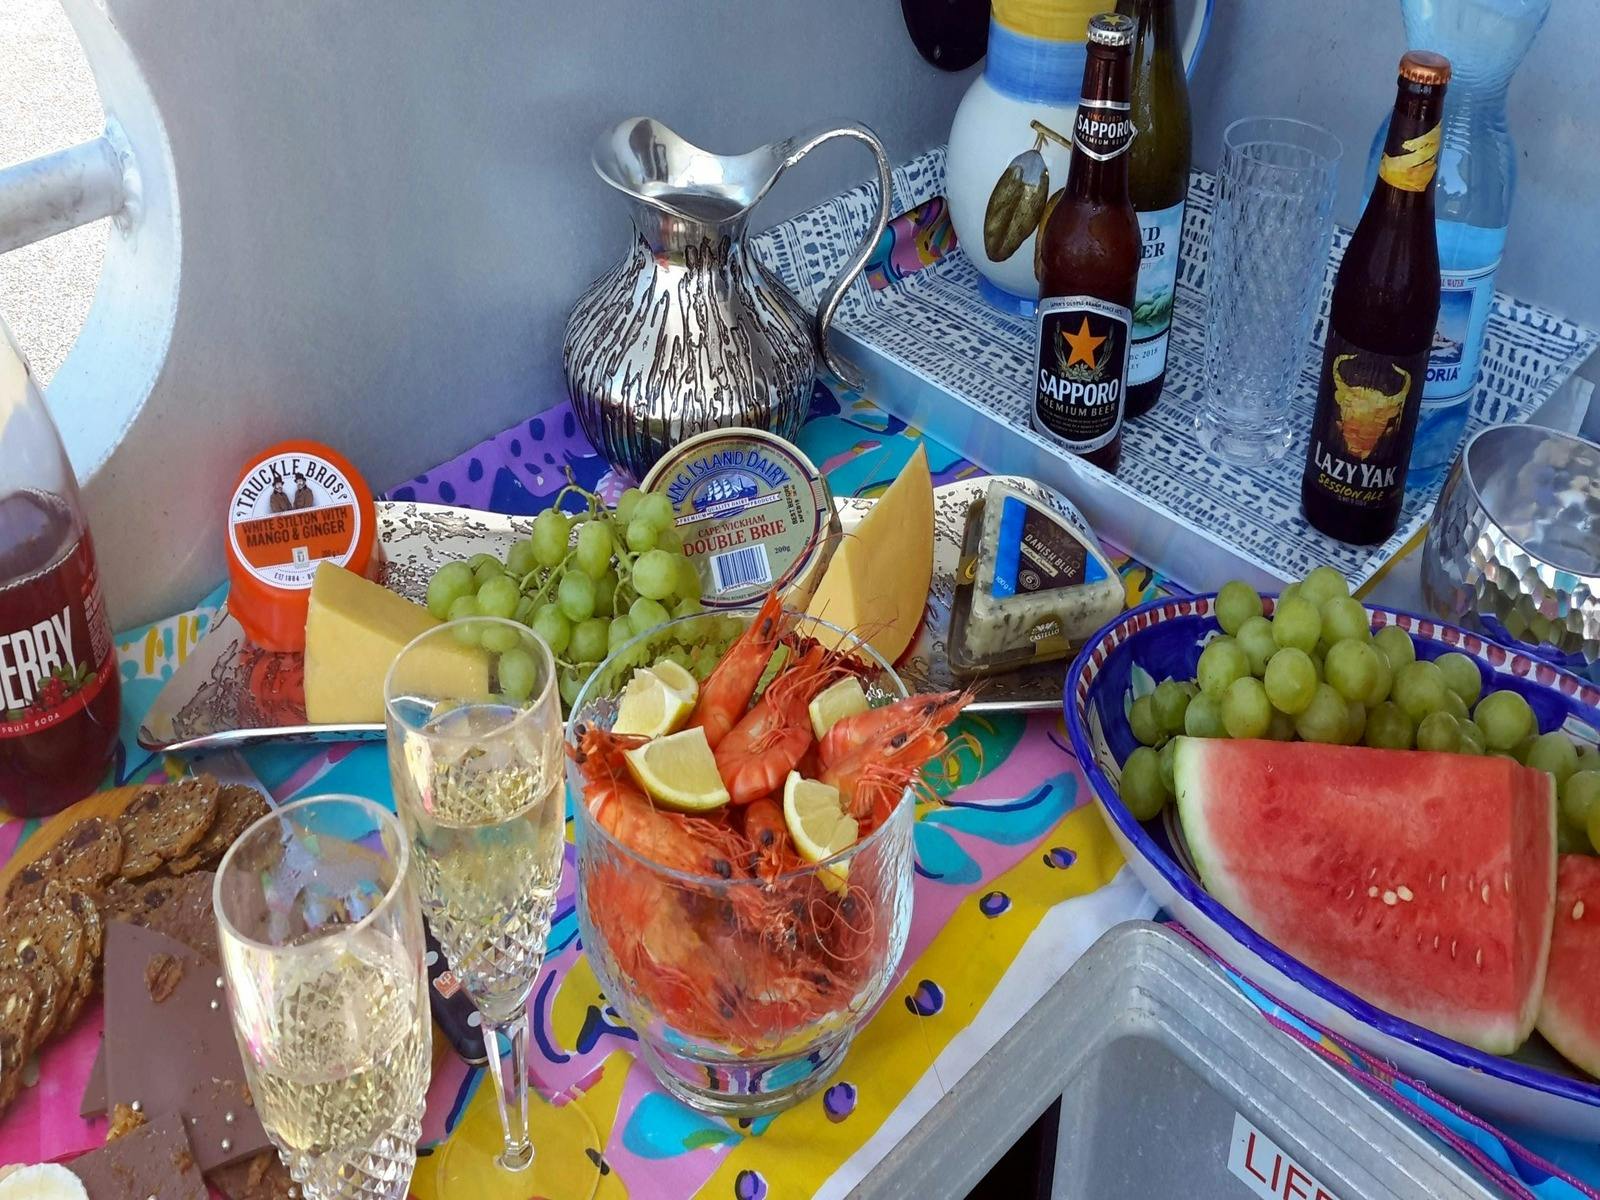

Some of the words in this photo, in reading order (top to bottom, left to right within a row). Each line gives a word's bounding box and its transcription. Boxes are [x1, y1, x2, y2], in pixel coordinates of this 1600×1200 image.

[1077, 113, 1129, 138] SAPPORO
[1039, 368, 1119, 407] SAPPORO
[1425, 368, 1459, 382] ORIA
[1040, 392, 1088, 417] PREMIUM
[1091, 403, 1115, 417] BEER
[686, 451, 744, 477] ISLAND
[747, 450, 792, 486] DAIRY
[1314, 440, 1357, 485] LAZY
[1360, 463, 1397, 488] YAK
[236, 458, 301, 509] TRUCKLE
[1318, 473, 1363, 500] SESSION
[1363, 490, 1385, 501] ALE
[707, 502, 731, 513] QUALITY
[750, 495, 777, 506] PRODUCE
[241, 519, 275, 535] WHITE
[278, 513, 319, 529] STILTON
[320, 507, 348, 522] WITH
[246, 529, 290, 548] MANGO
[292, 529, 299, 541] &
[303, 519, 346, 538] GINGER
[698, 526, 721, 538] CAPE
[722, 514, 766, 531] WICKHAM
[683, 530, 747, 557] DOUBLE
[749, 519, 787, 541] BRIE
[774, 544, 791, 554] 200g
[1024, 533, 1056, 563] DANISH
[1055, 558, 1077, 578] BLUE
[1029, 628, 1060, 642] CASTELLO
[0, 605, 77, 712] ERRY
[1, 723, 30, 734] FRUIT
[34, 712, 60, 728] SODA
[1245, 1131, 1334, 1200] LIF
